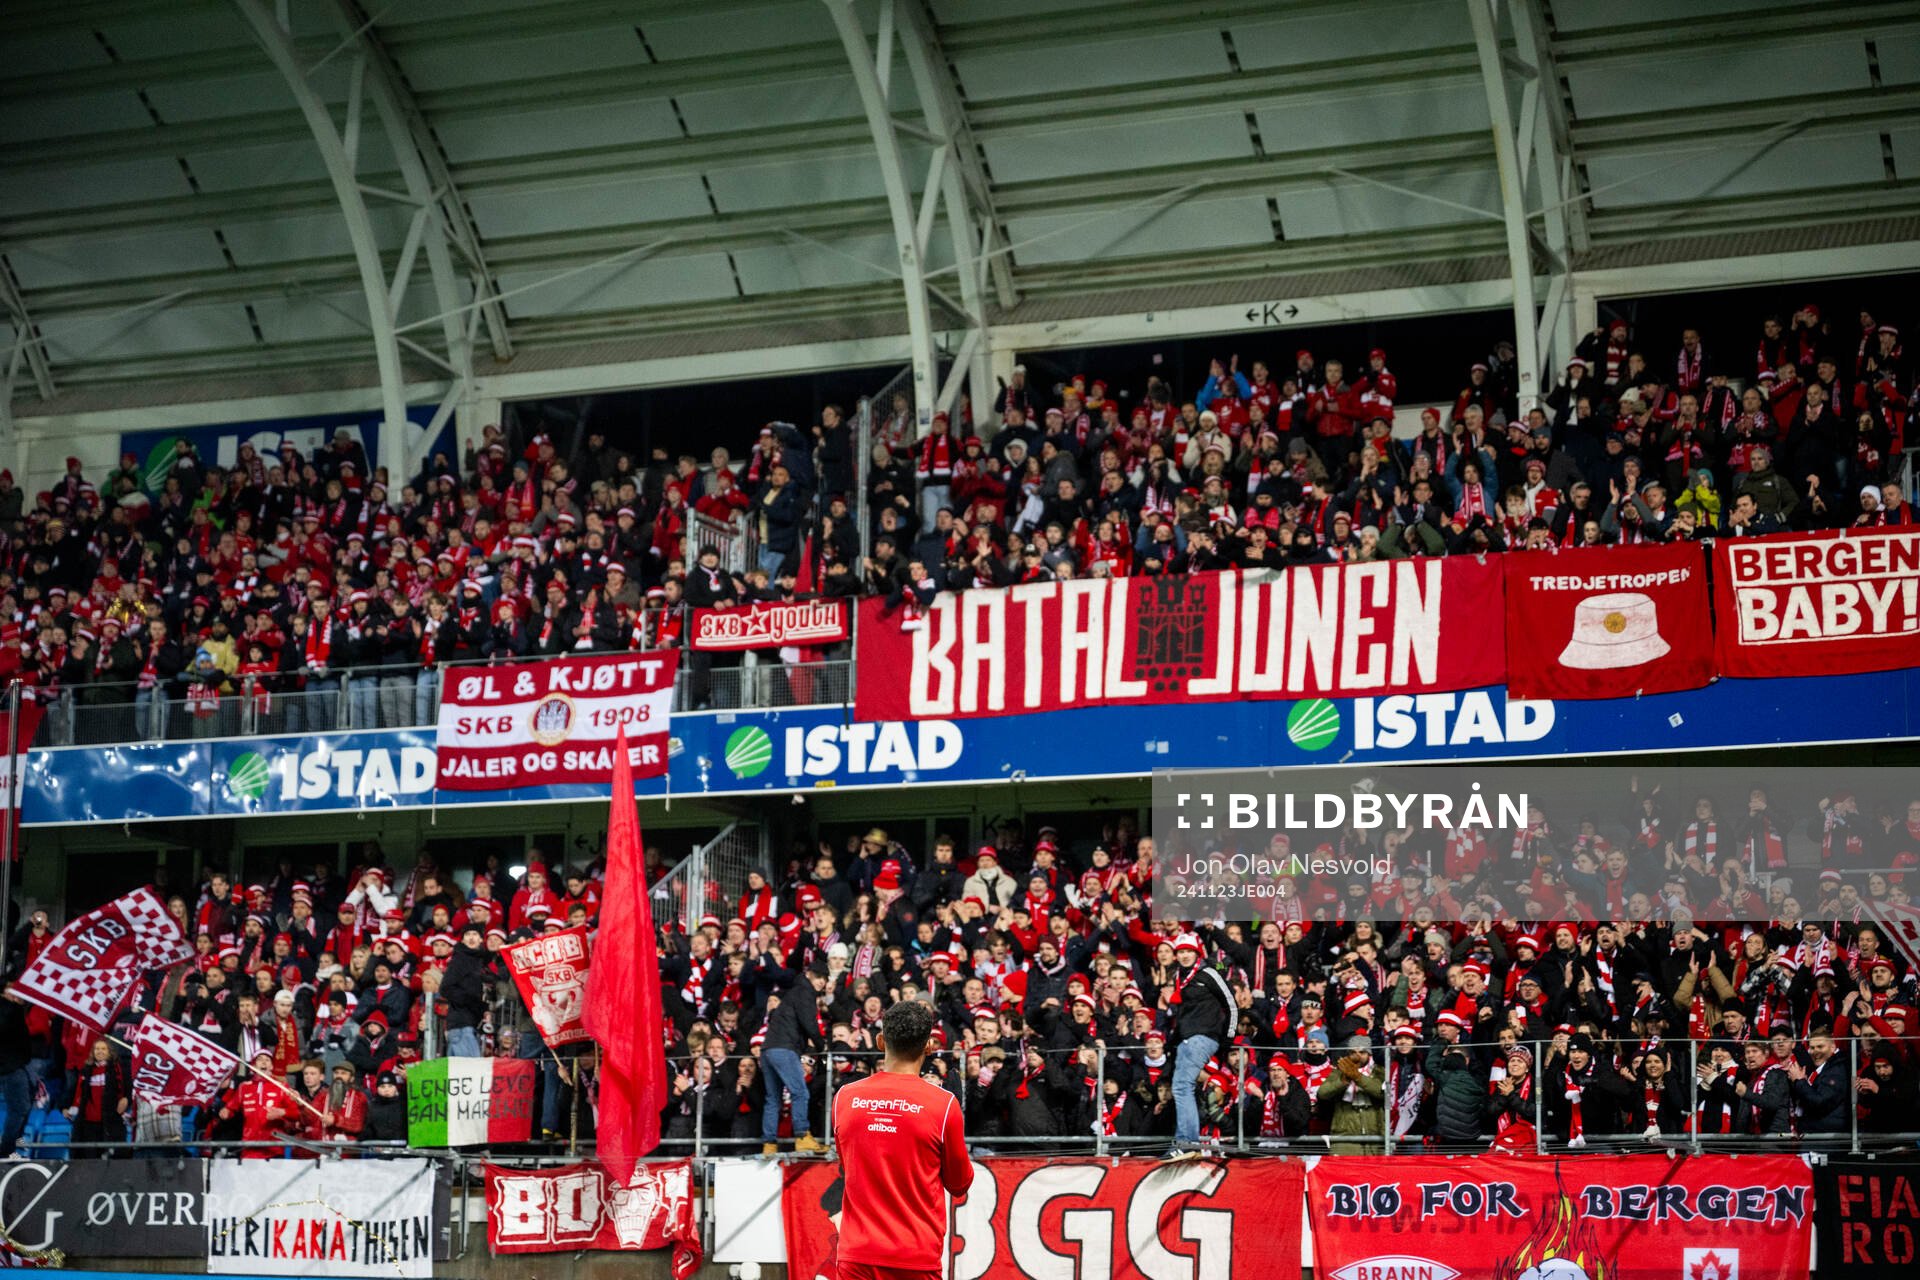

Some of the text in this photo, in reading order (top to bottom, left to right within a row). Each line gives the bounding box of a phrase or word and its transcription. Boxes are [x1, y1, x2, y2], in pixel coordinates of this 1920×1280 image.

[1263, 302, 1281, 325] K
[1734, 539, 1920, 582] BERGEN
[1529, 566, 1691, 591] TREDJETROPPEN
[700, 613, 743, 638] SKB
[1737, 578, 1919, 641] BABY!
[457, 660, 664, 700] ØL & KJØTT
[456, 704, 651, 735] SKB 1908
[1354, 691, 1556, 750] ISTAD
[522, 753, 558, 771] OG
[563, 744, 660, 771] SKÅER
[784, 720, 964, 777] ISTAD
[281, 747, 438, 801] ISTAD
[66, 917, 128, 969] SKB
[547, 969, 573, 983] SKB
[409, 1075, 531, 1101] LENGE LEVE
[851, 1096, 925, 1114] BergenFiber
[1416, 1181, 1530, 1222] FOR
[1580, 1183, 1811, 1228] BERGEN
